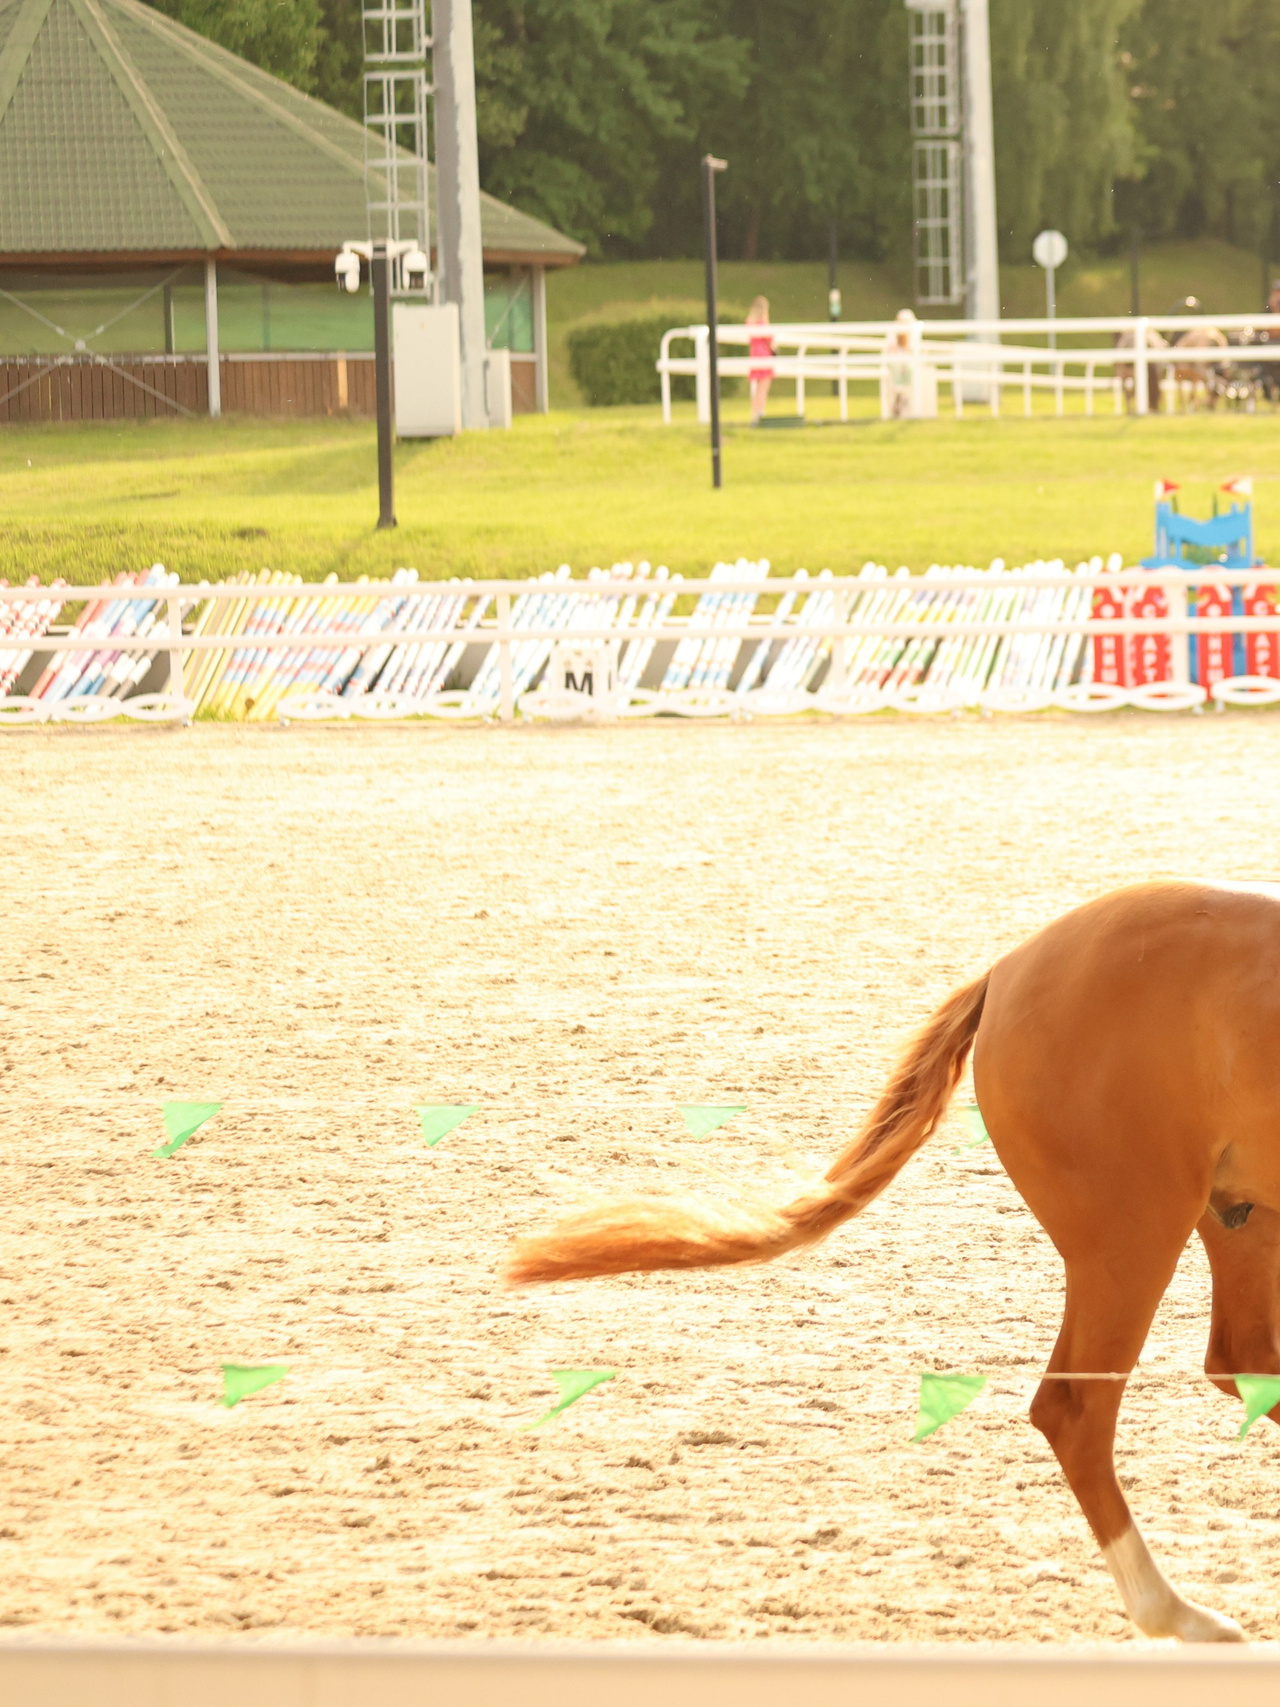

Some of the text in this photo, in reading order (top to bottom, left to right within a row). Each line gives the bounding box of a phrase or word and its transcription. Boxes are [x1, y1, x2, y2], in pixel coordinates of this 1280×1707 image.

[1100, 603, 1118, 683] ФНИШ
[1142, 603, 1158, 683] САРТ
[1206, 603, 1224, 684] ФНИШ
[1253, 600, 1270, 677] САРТ
[565, 670, 593, 696] M
